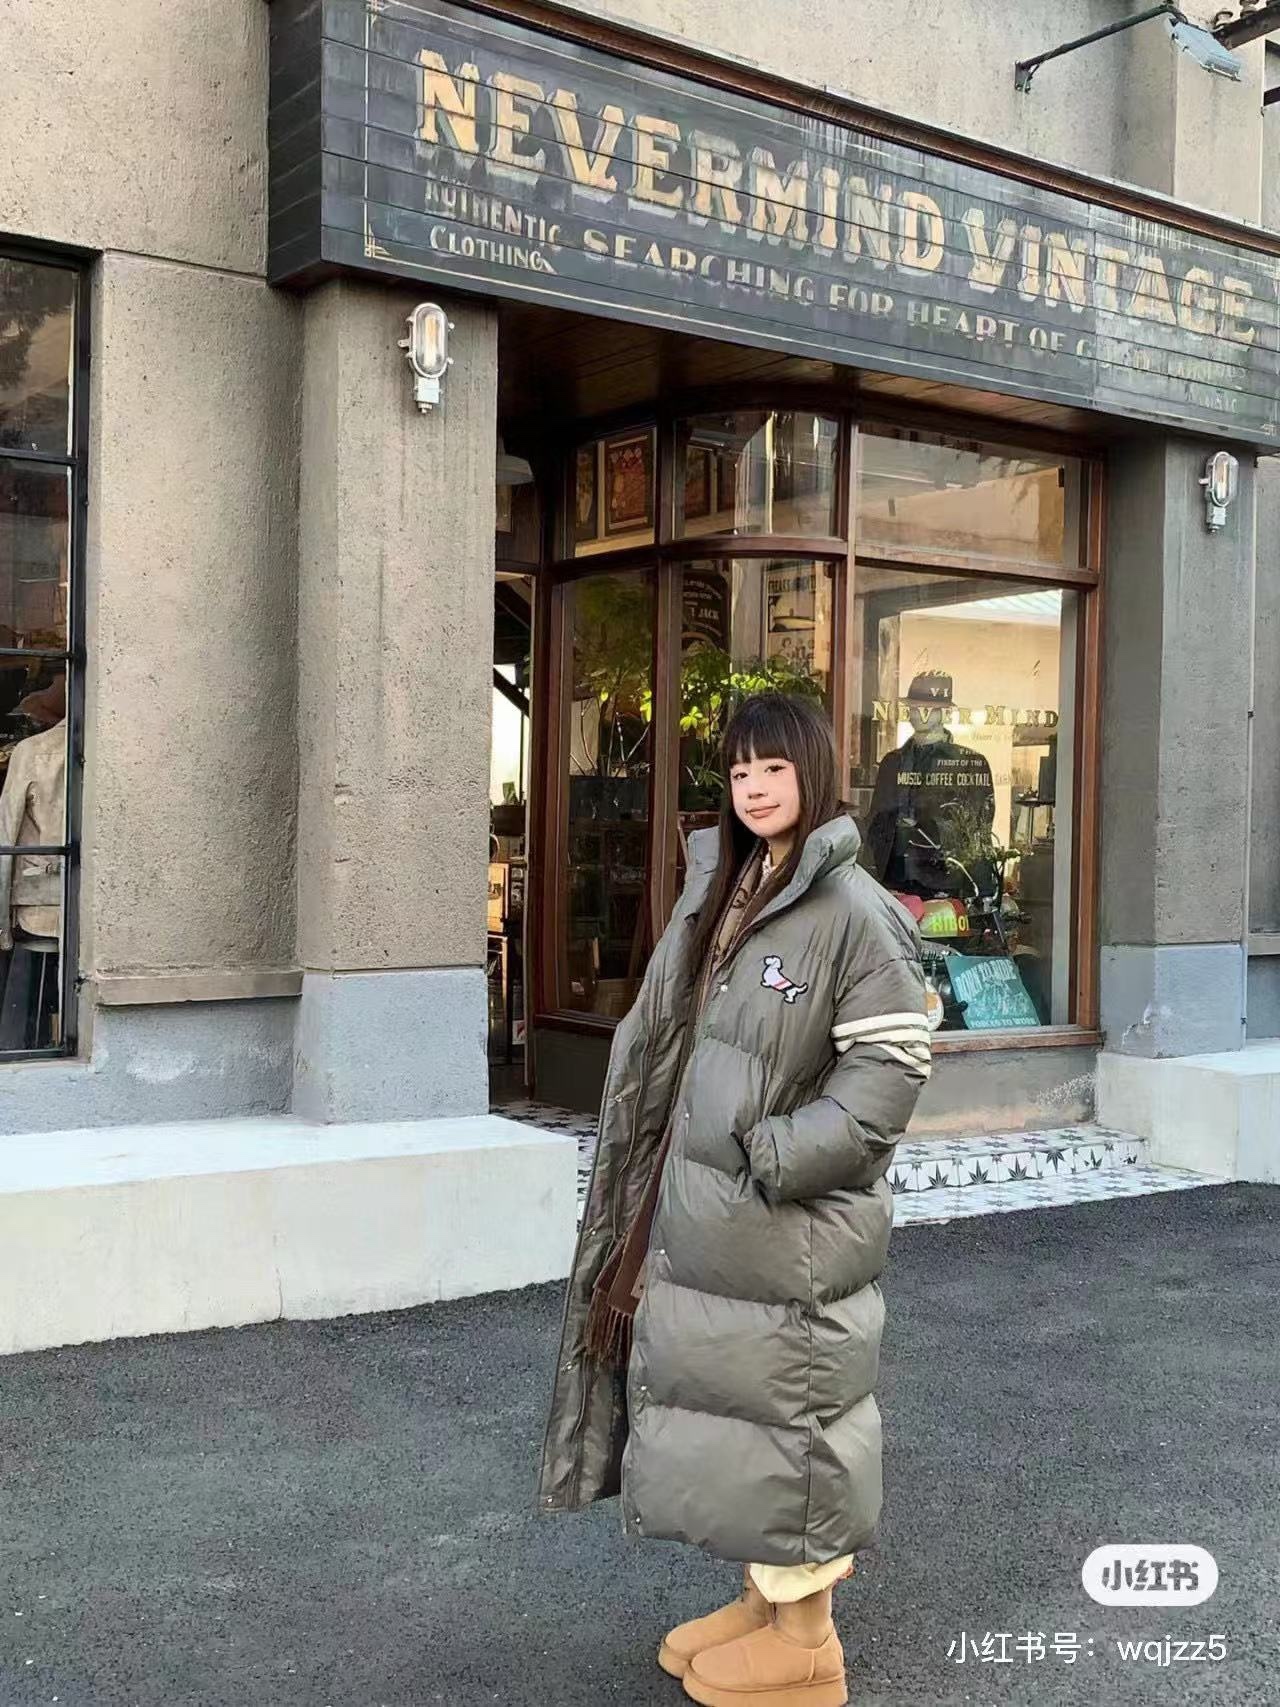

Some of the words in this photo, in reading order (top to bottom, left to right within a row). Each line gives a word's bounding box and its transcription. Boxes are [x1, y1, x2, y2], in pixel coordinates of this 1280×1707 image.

[414, 47, 946, 277] NEVERMIND
[961, 206, 1255, 350] VINTAGE
[429, 224, 558, 276] CLOTHING
[871, 700, 972, 725] NEVER
[984, 704, 1059, 728] MIND
[897, 772, 922, 786] MUSIC
[925, 772, 953, 786] COFFEE
[956, 773, 992, 787] COCKTAIL
